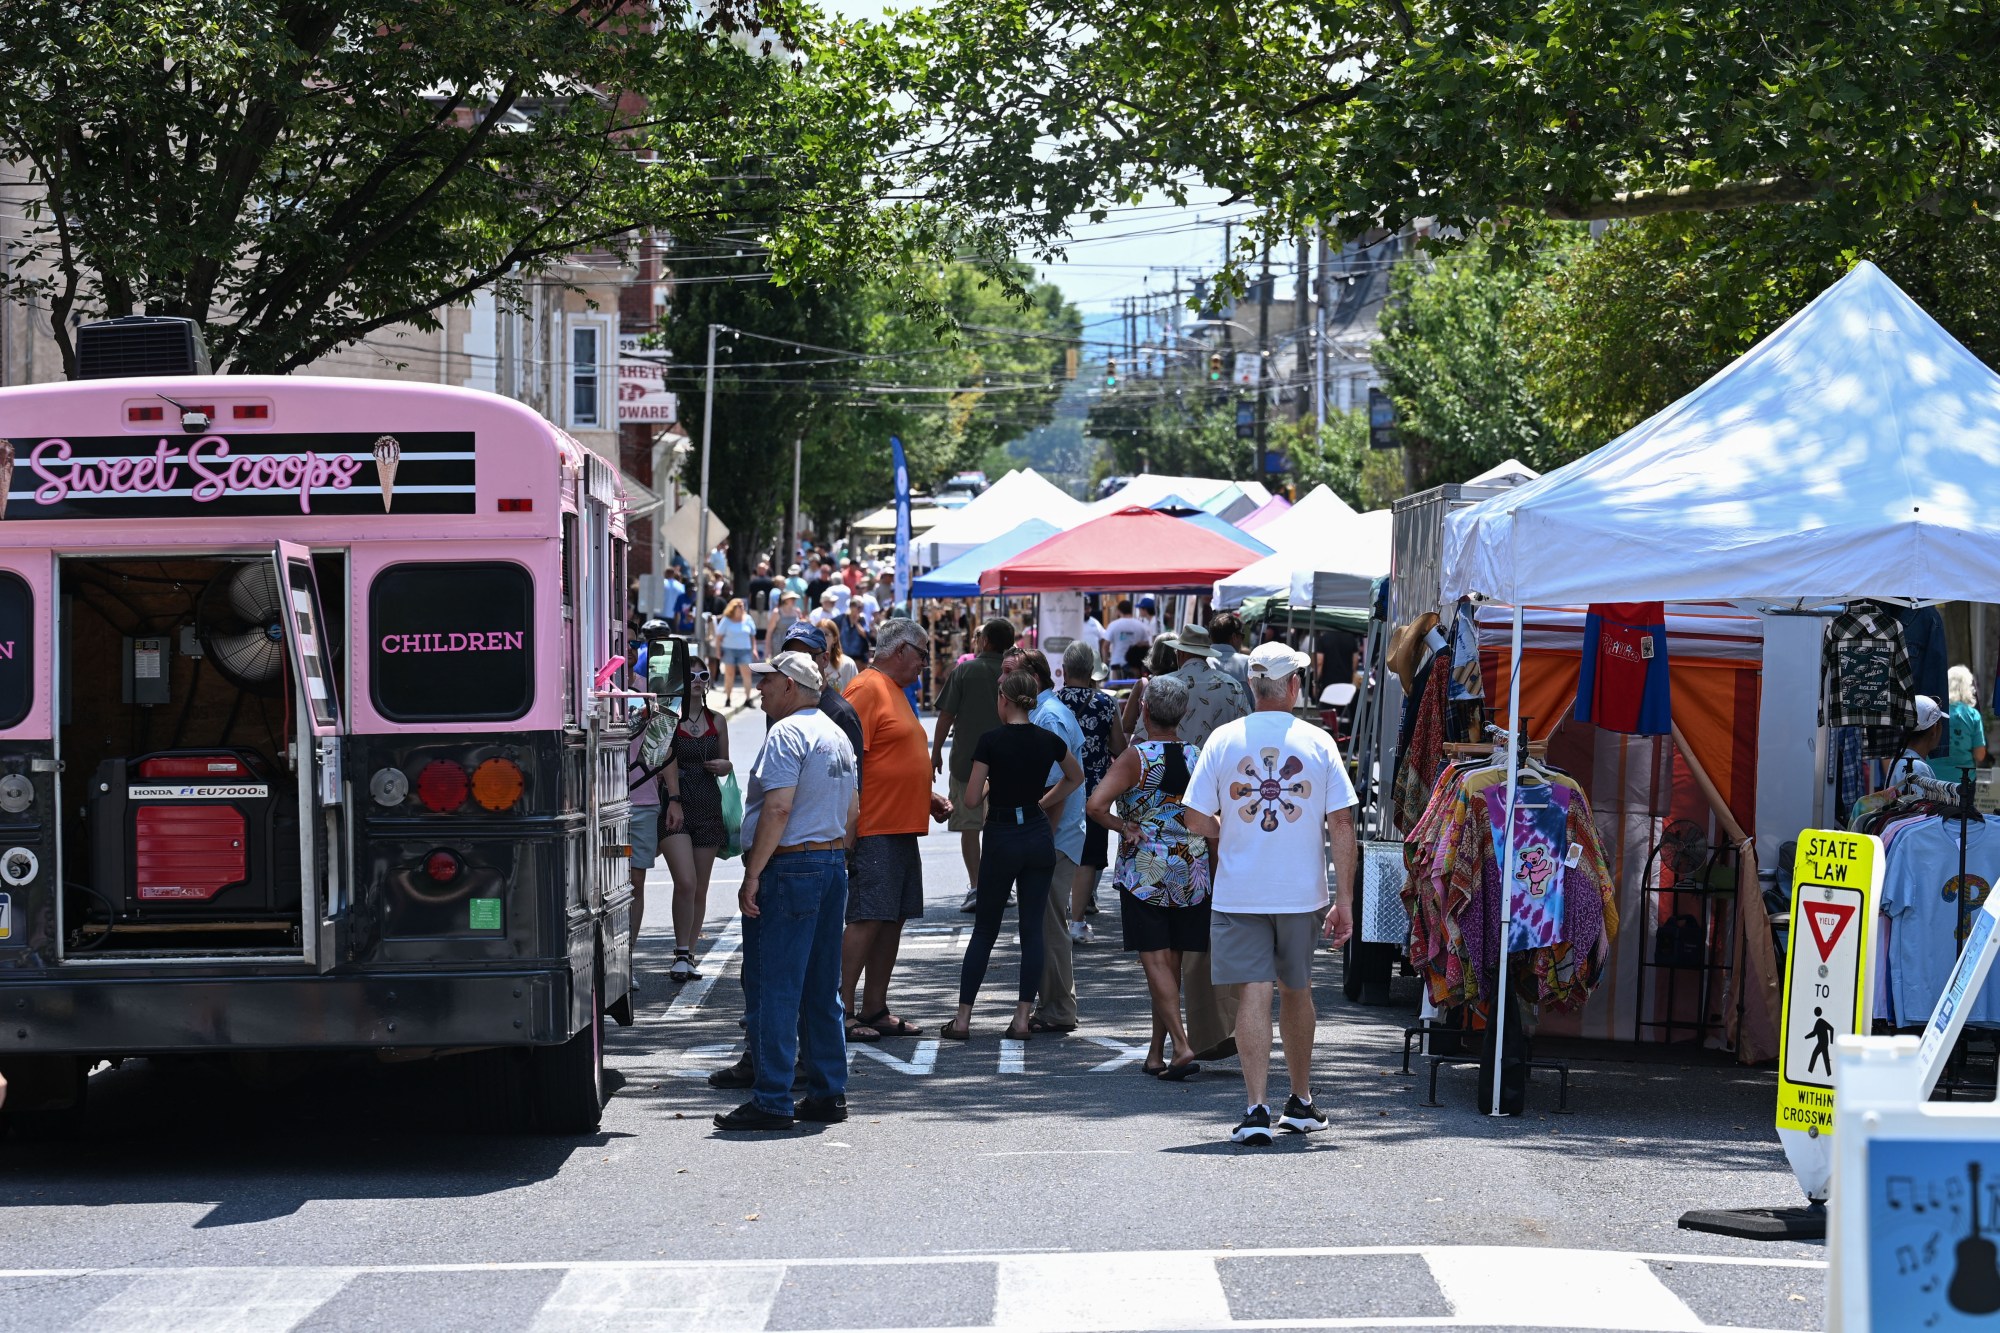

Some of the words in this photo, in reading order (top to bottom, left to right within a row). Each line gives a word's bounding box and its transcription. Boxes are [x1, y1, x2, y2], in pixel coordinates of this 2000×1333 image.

[620, 340, 635, 350] 59
[30, 438, 180, 505] Sweet
[187, 436, 362, 514] Scoops
[381, 631, 524, 653] CHILDREN
[1809, 838, 1858, 860] STATE
[1814, 861, 1848, 882] LAW
[1820, 917, 1835, 926] YIELD
[1815, 984, 1830, 999] TO
[1798, 1090, 1834, 1108] WITHIN
